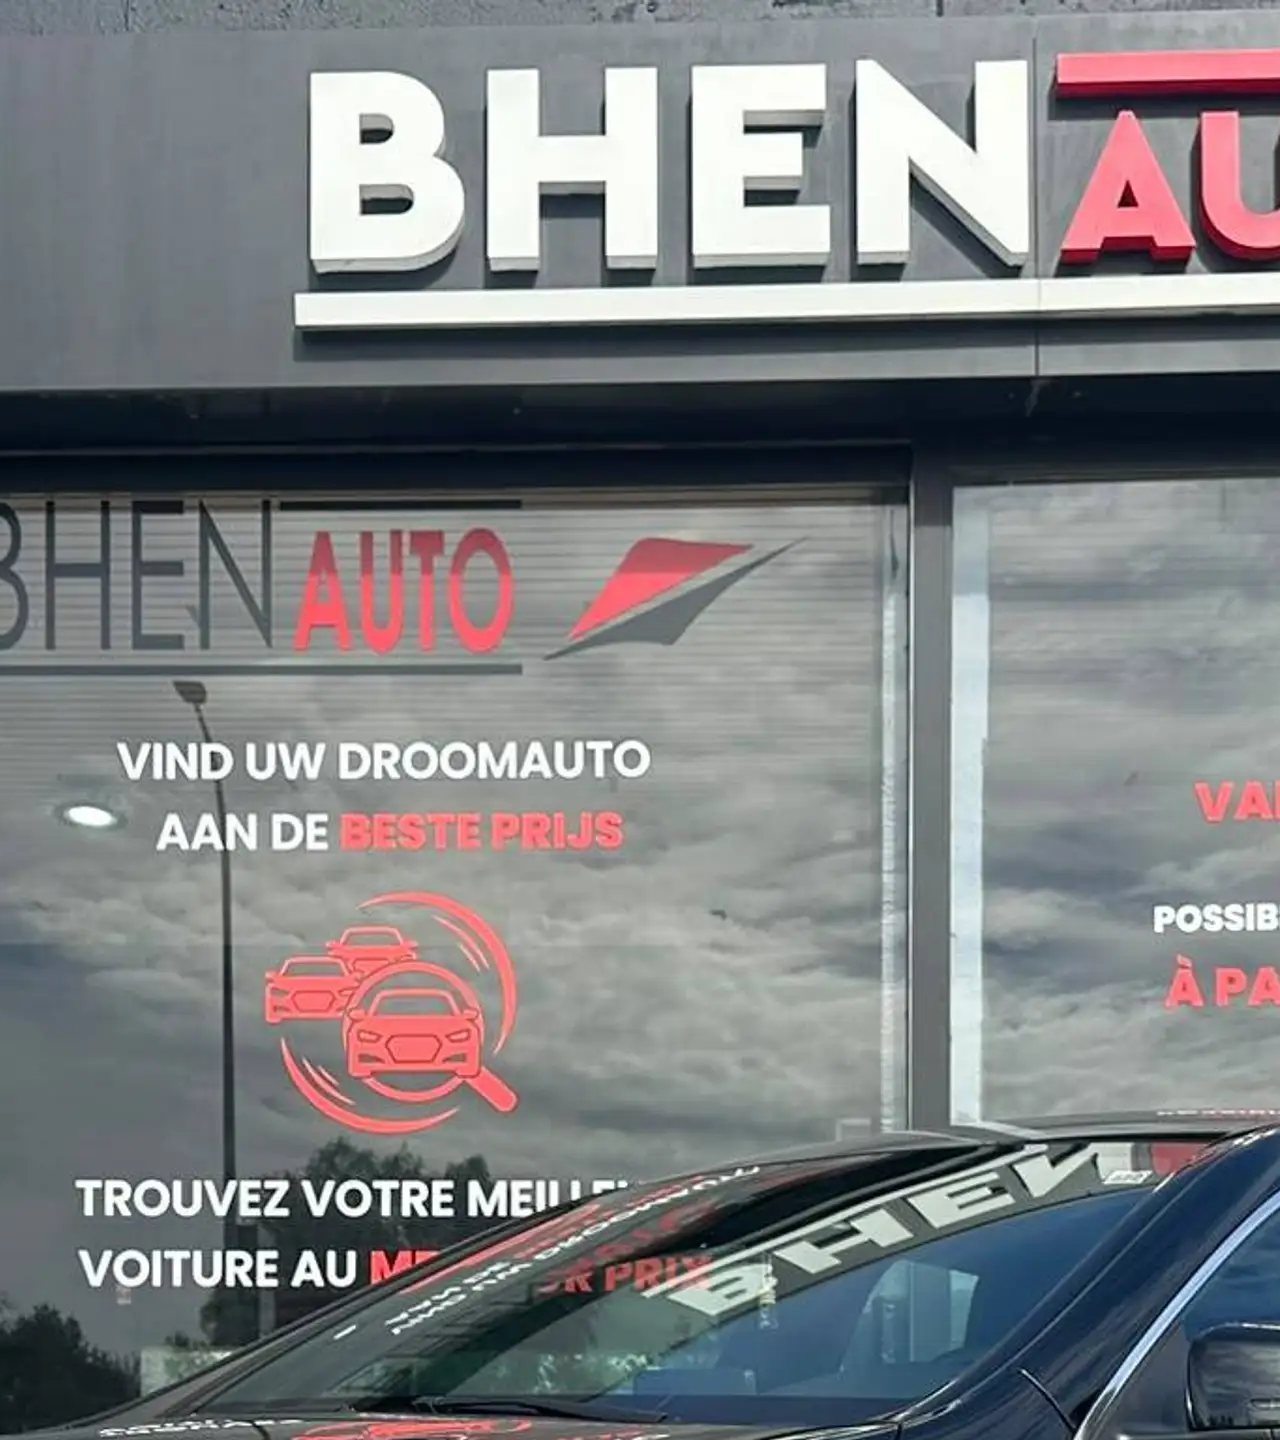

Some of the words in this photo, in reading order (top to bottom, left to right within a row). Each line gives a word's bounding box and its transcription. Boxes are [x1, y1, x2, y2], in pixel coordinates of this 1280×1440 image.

[310, 59, 1030, 272] BHEN
[293, 528, 515, 654] AUTO
[117, 741, 234, 780] VIND
[246, 741, 327, 780] UW
[337, 740, 652, 780] DROOMAUTO
[156, 813, 259, 852] AAN
[270, 813, 329, 851] DE
[339, 811, 482, 852] BESTE
[489, 811, 625, 851] PRIJS
[1165, 955, 1206, 1009] À
[75, 1179, 290, 1218] TROUVEZ
[300, 1179, 455, 1218] VOTRE
[77, 1249, 279, 1288] VOITURE
[290, 1249, 357, 1288] AU
